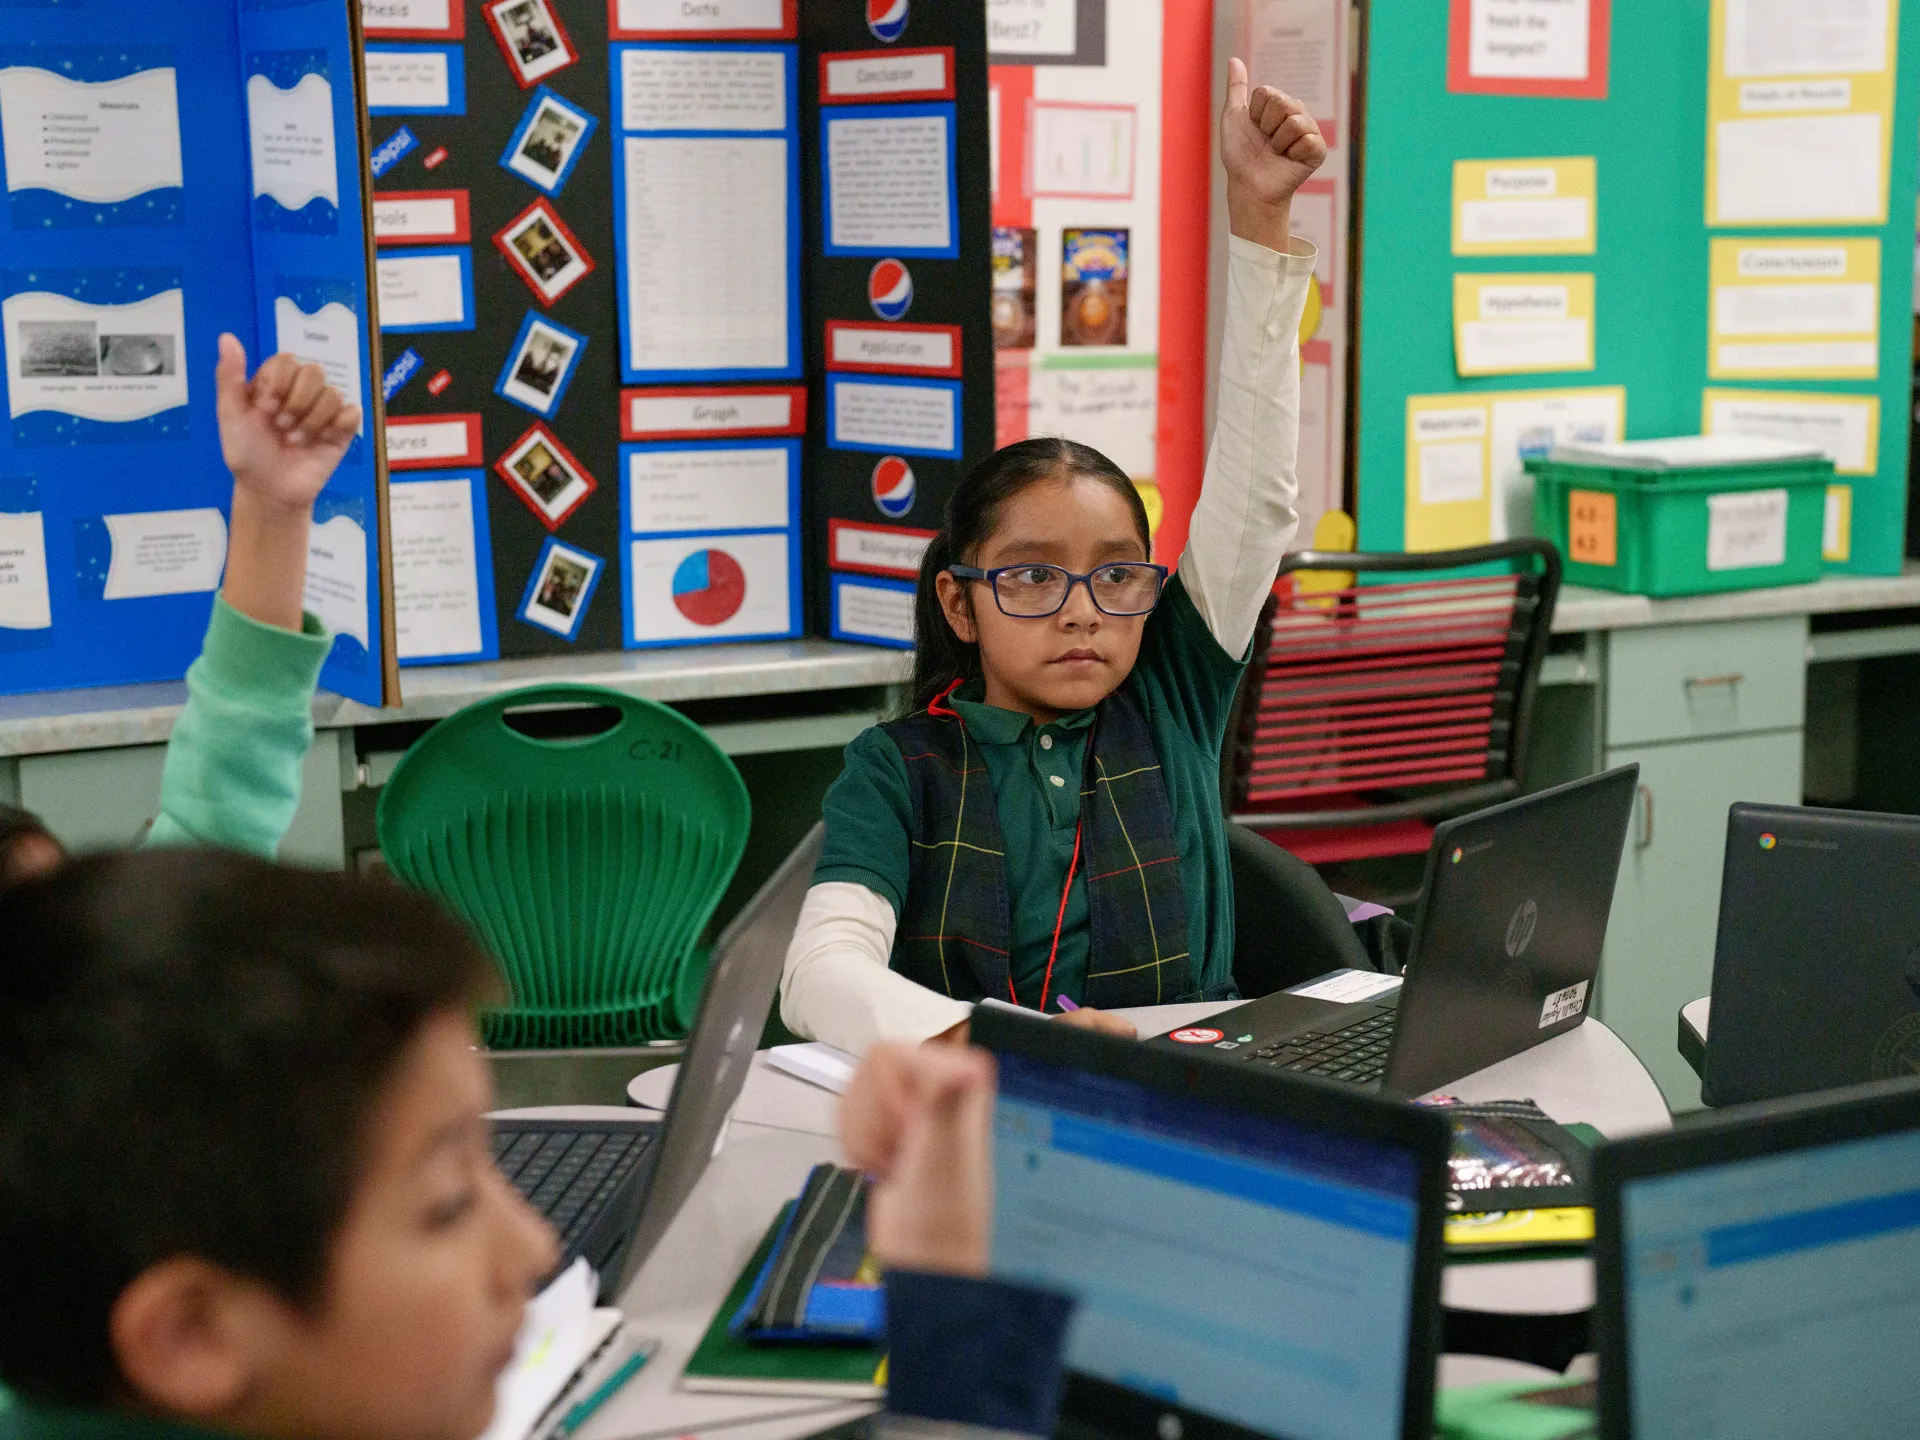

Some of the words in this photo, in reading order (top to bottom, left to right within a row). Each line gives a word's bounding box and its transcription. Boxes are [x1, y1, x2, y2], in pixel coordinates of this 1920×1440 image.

[682, 2, 720, 17] Data
[856, 67, 914, 84] Conclusion
[860, 338, 924, 356] Application
[692, 404, 740, 422] Graph
